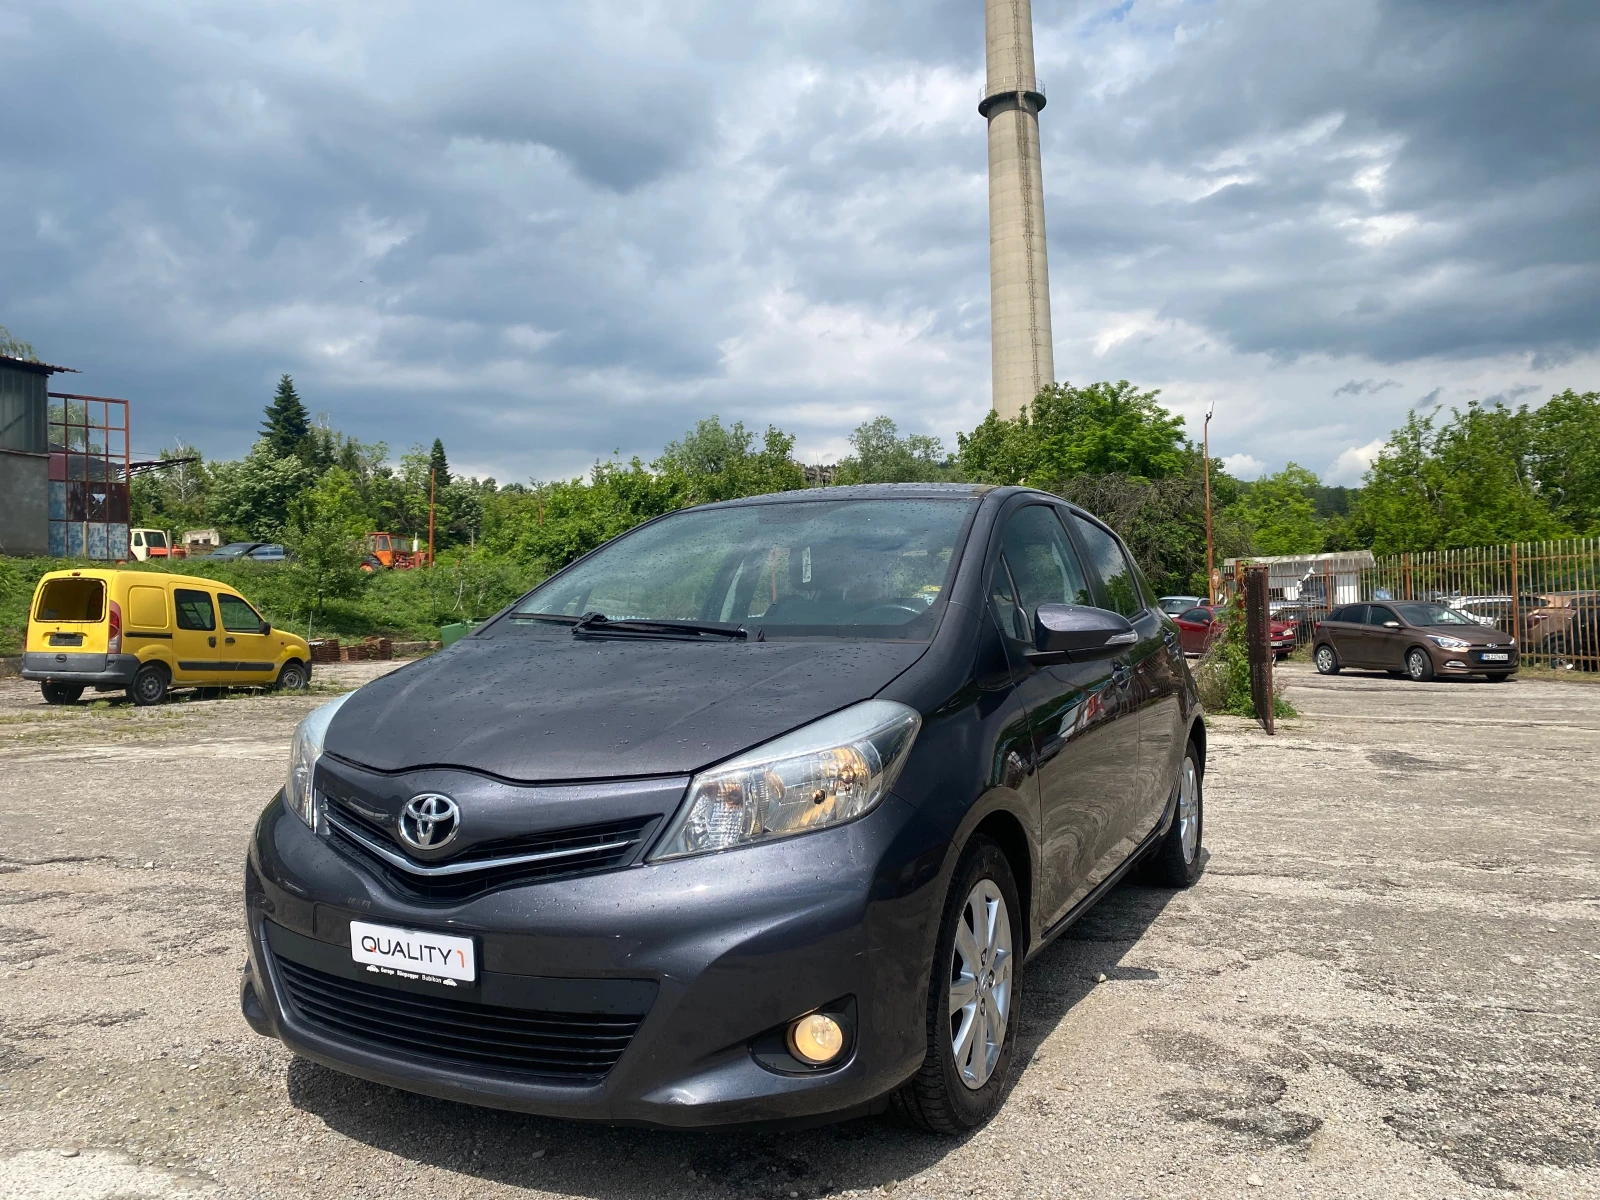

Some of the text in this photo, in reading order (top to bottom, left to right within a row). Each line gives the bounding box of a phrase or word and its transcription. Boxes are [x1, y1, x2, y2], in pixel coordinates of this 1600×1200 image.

[361, 935, 465, 969] QUALITY 1
[380, 967, 395, 976] Garage
[422, 974, 442, 984] Bubikon
